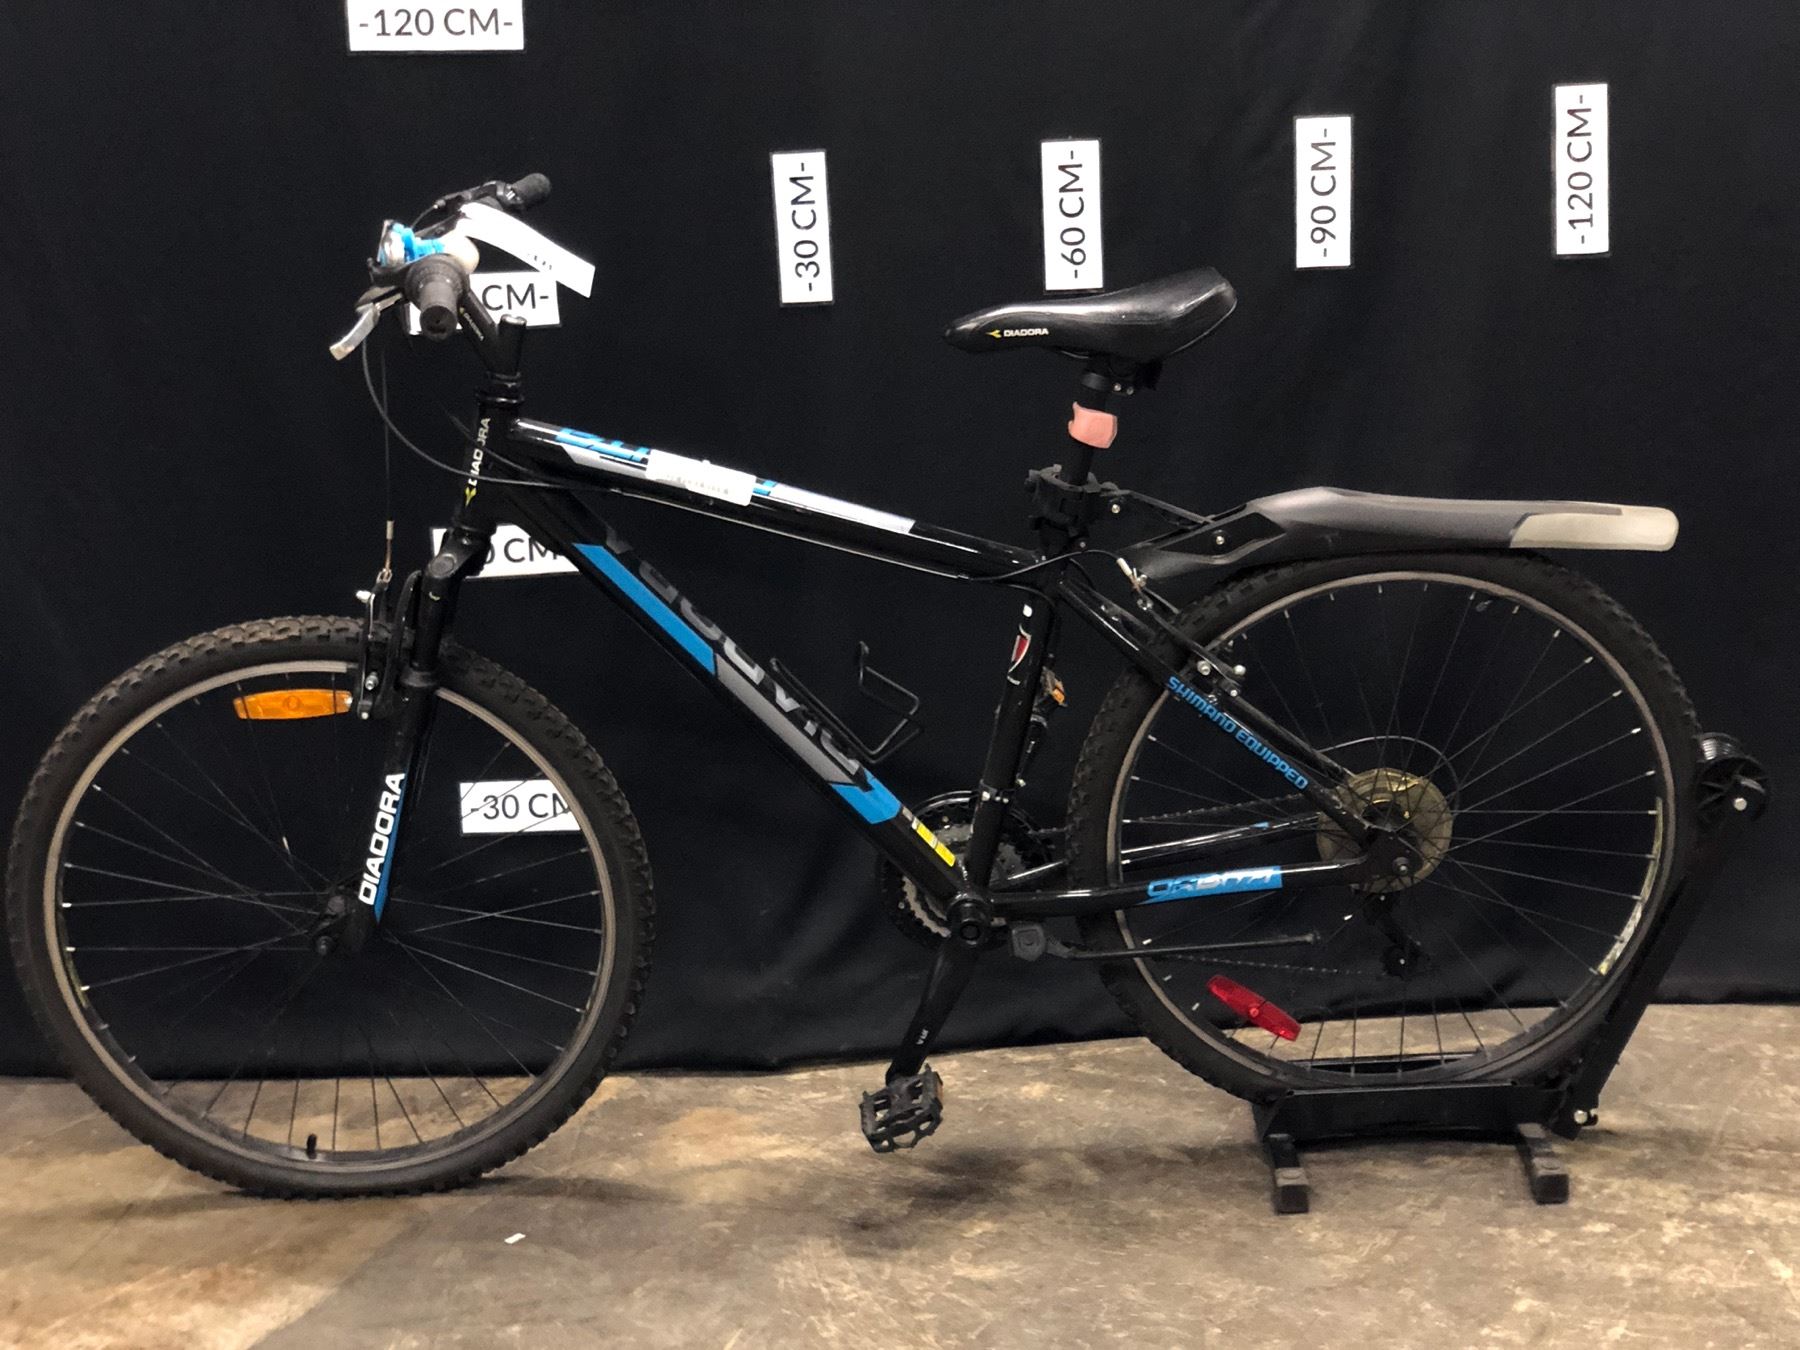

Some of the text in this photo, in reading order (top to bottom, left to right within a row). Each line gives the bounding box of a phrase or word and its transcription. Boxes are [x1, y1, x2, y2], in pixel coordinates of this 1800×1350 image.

[359, 8, 513, 36] -120 CM-
[788, 162, 820, 292] -30 CM-
[1058, 150, 1086, 278] -60 CM-
[1310, 128, 1336, 257] -90 CM-
[1566, 94, 1593, 244] -120 CM-
[481, 283, 549, 311] CM-
[1003, 327, 1049, 338] DIADORA
[1168, 676, 1309, 790] SHIMANO EQUIPPED
[357, 773, 406, 906] DIADORA
[470, 794, 520, 820] -30
